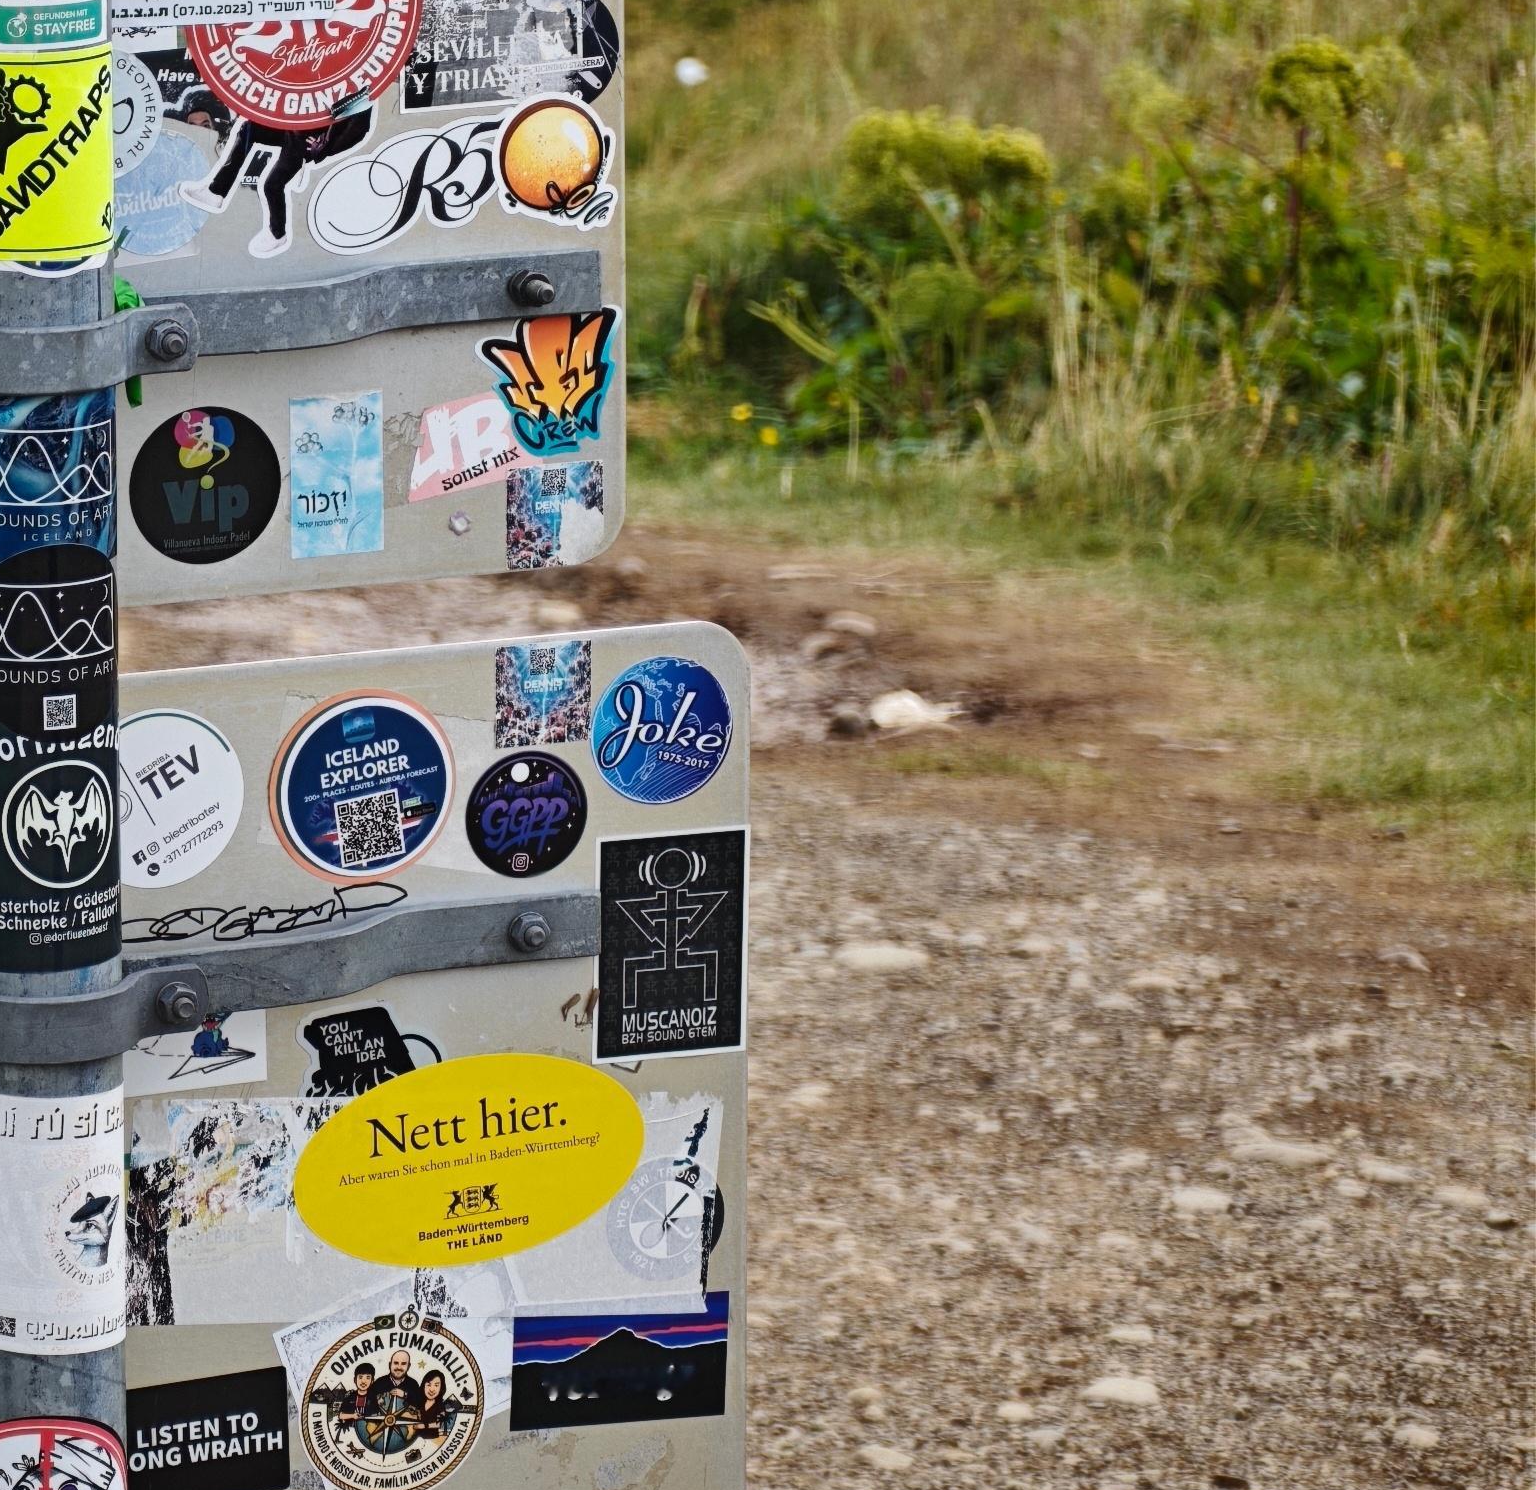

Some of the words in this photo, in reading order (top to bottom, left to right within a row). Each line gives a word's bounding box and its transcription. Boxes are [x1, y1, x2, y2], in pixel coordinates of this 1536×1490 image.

[33, 10, 76, 22] GEFUNDEN
[33, 17, 96, 36] STAYFREE
[264, 25, 363, 78] Stuttgart
[157, 68, 196, 83] Have
[208, 45, 279, 112] DURCH
[116, 58, 156, 159] GEOTHERMAL
[68, 507, 90, 526] OF
[162, 474, 251, 533] Vip
[22, 528, 93, 542] ICELAND
[163, 535, 201, 550] Villanueva
[68, 664, 90, 682] OF
[600, 682, 725, 770] Joke
[325, 738, 401, 769] ICELAND
[657, 749, 711, 771] 1975-2017
[139, 744, 201, 800] TEV
[320, 755, 411, 790] EXPLORER
[319, 1020, 349, 1036] YOU
[621, 1005, 718, 1033] MUSCANOIZ
[334, 1041, 361, 1057] KILL
[364, 1036, 385, 1051] AN
[647, 1028, 685, 1043] SOUND
[356, 1048, 387, 1064] IDEA
[366, 1112, 467, 1159] Nett
[478, 1097, 568, 1140] hier.
[338, 1173, 366, 1187] Aber
[368, 1168, 400, 1182] waren
[402, 1164, 419, 1176] Sie
[420, 1158, 451, 1174] schon
[453, 1152, 474, 1168] mal
[489, 1132, 601, 1162] Baden-Württemberg?
[418, 1213, 530, 1242] Baden-Württemberg
[447, 1238, 470, 1251] THE
[472, 1232, 504, 1247] LÄND
[330, 1334, 385, 1376] OHARA
[136, 1417, 222, 1450] LISTEN
[226, 1411, 260, 1434] TO
[189, 1430, 285, 1465] WRAITH
